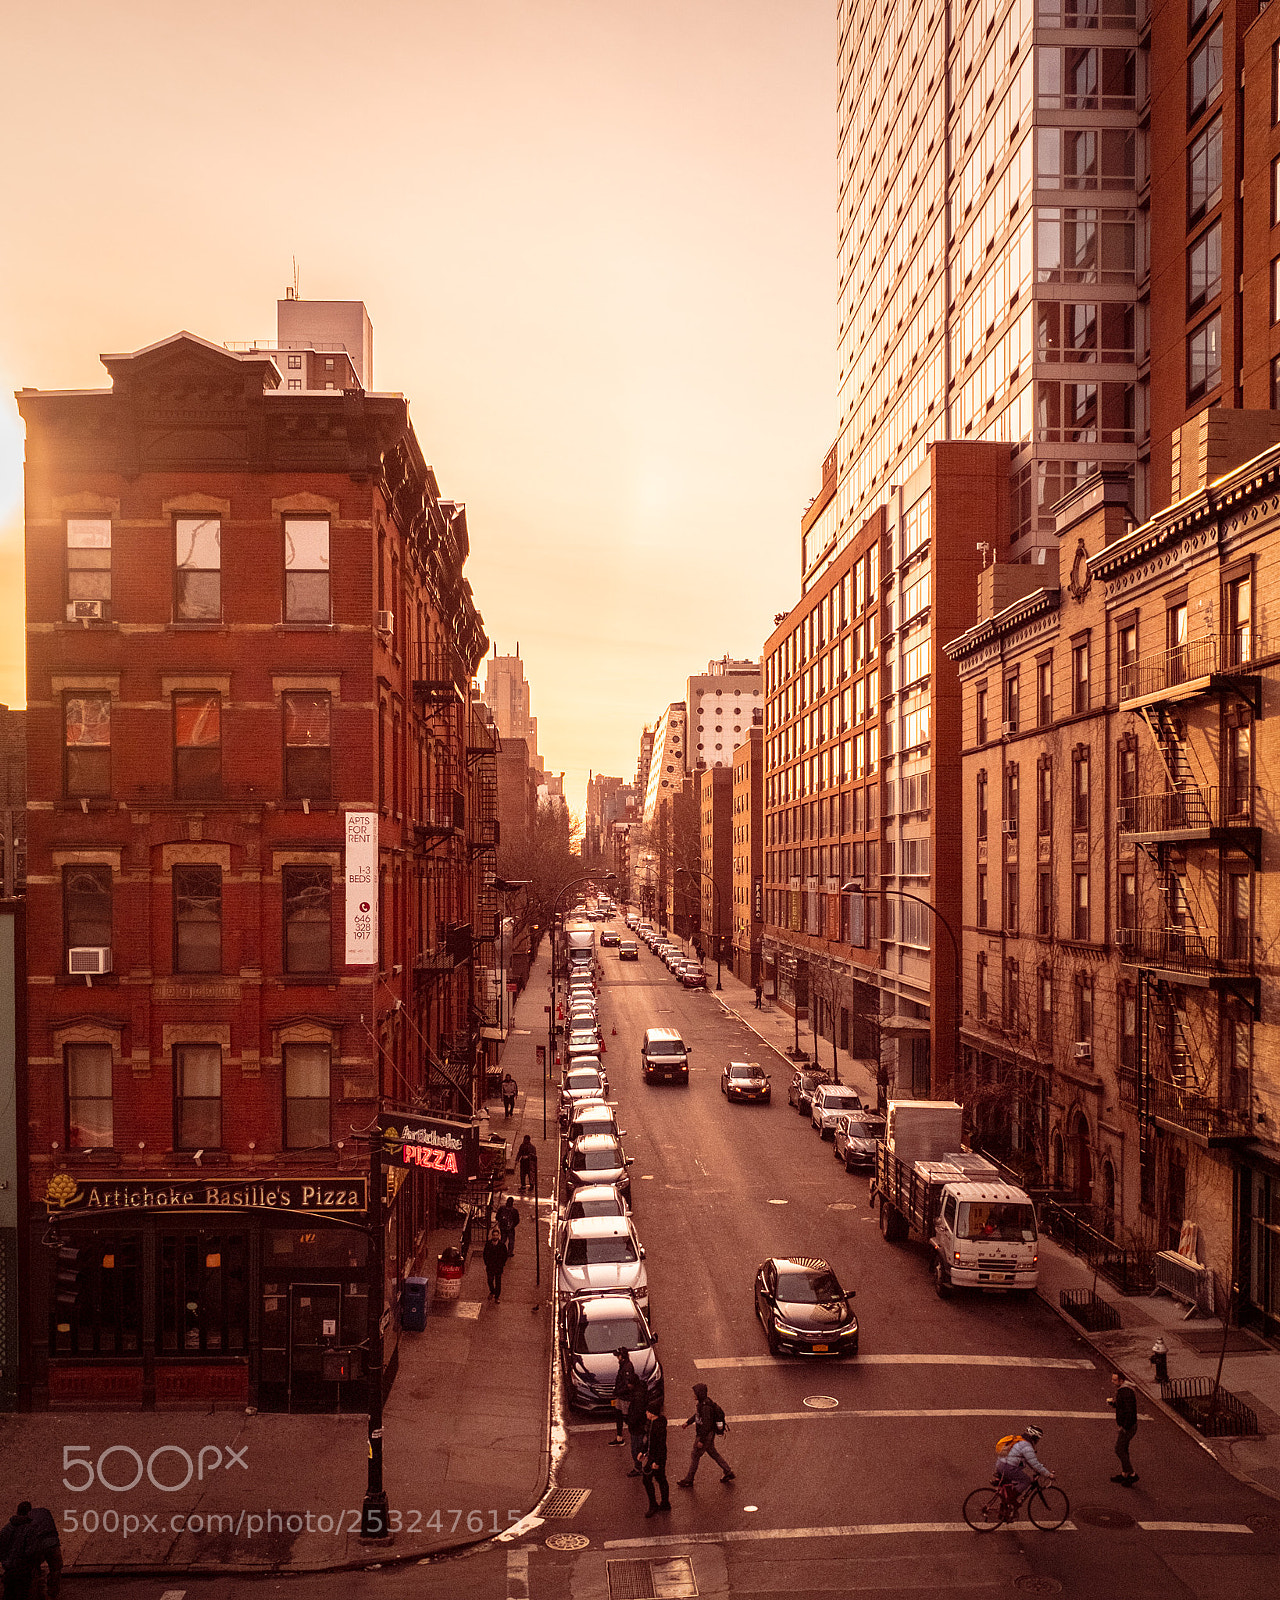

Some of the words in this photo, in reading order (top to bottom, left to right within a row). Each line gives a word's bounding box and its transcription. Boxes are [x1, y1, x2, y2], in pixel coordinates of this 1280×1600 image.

[348, 816, 370, 825] APTS
[348, 825, 367, 834] FOR
[348, 834, 370, 843] RENT
[358, 866, 371, 874] 1-3
[349, 874, 371, 883] BEDS
[354, 915, 371, 923] 646
[355, 923, 371, 932] 328
[353, 931, 371, 940] 1917
[403, 1144, 459, 1174] PIZZA
[88, 1186, 194, 1207] Artichoke
[206, 1186, 291, 1207] Basille's
[302, 1186, 359, 1206] Pizza
